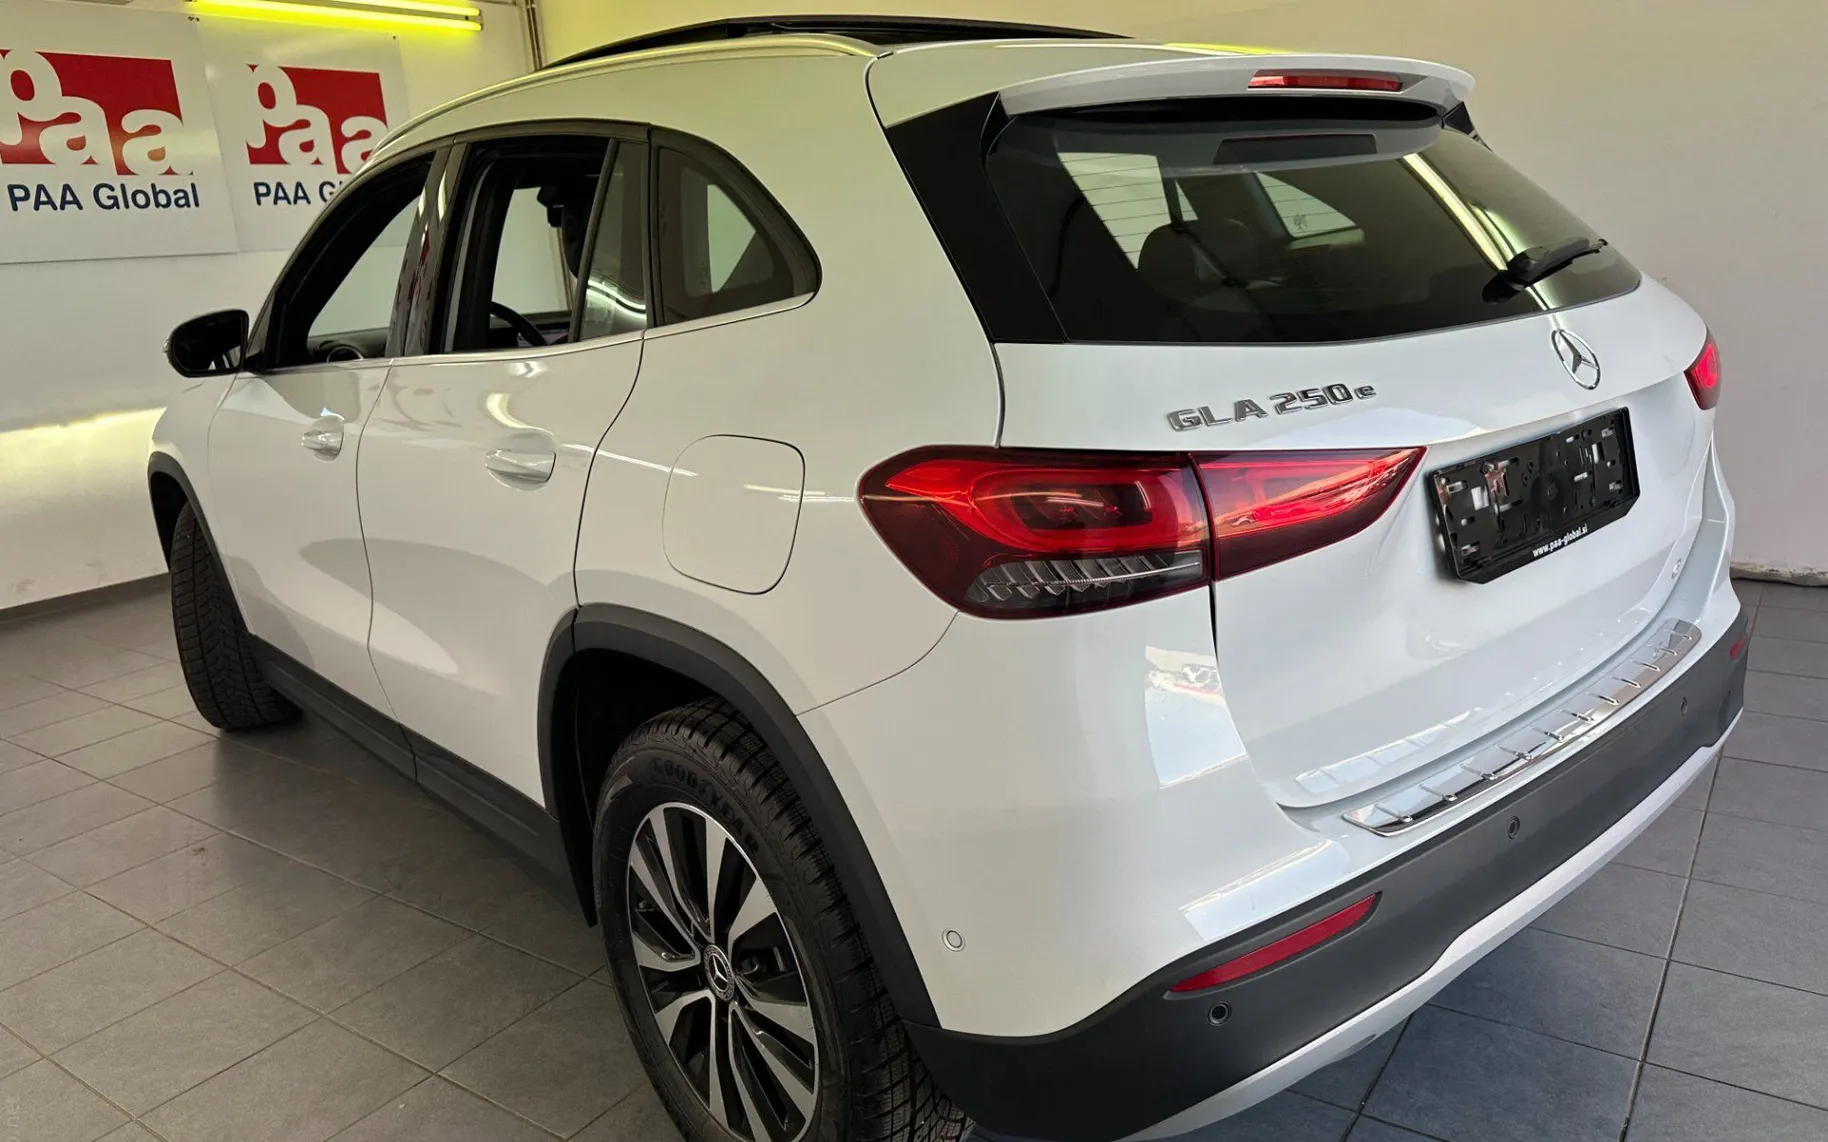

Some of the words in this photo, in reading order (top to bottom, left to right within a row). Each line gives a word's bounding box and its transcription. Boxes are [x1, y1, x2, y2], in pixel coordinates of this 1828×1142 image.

[7, 183, 83, 212] PAA
[93, 182, 200, 210] Global
[253, 181, 311, 206] PAA
[1167, 398, 1269, 432] GLA
[1532, 523, 1588, 557] www.paa-global.si
[651, 757, 759, 853] GOODYEAR
